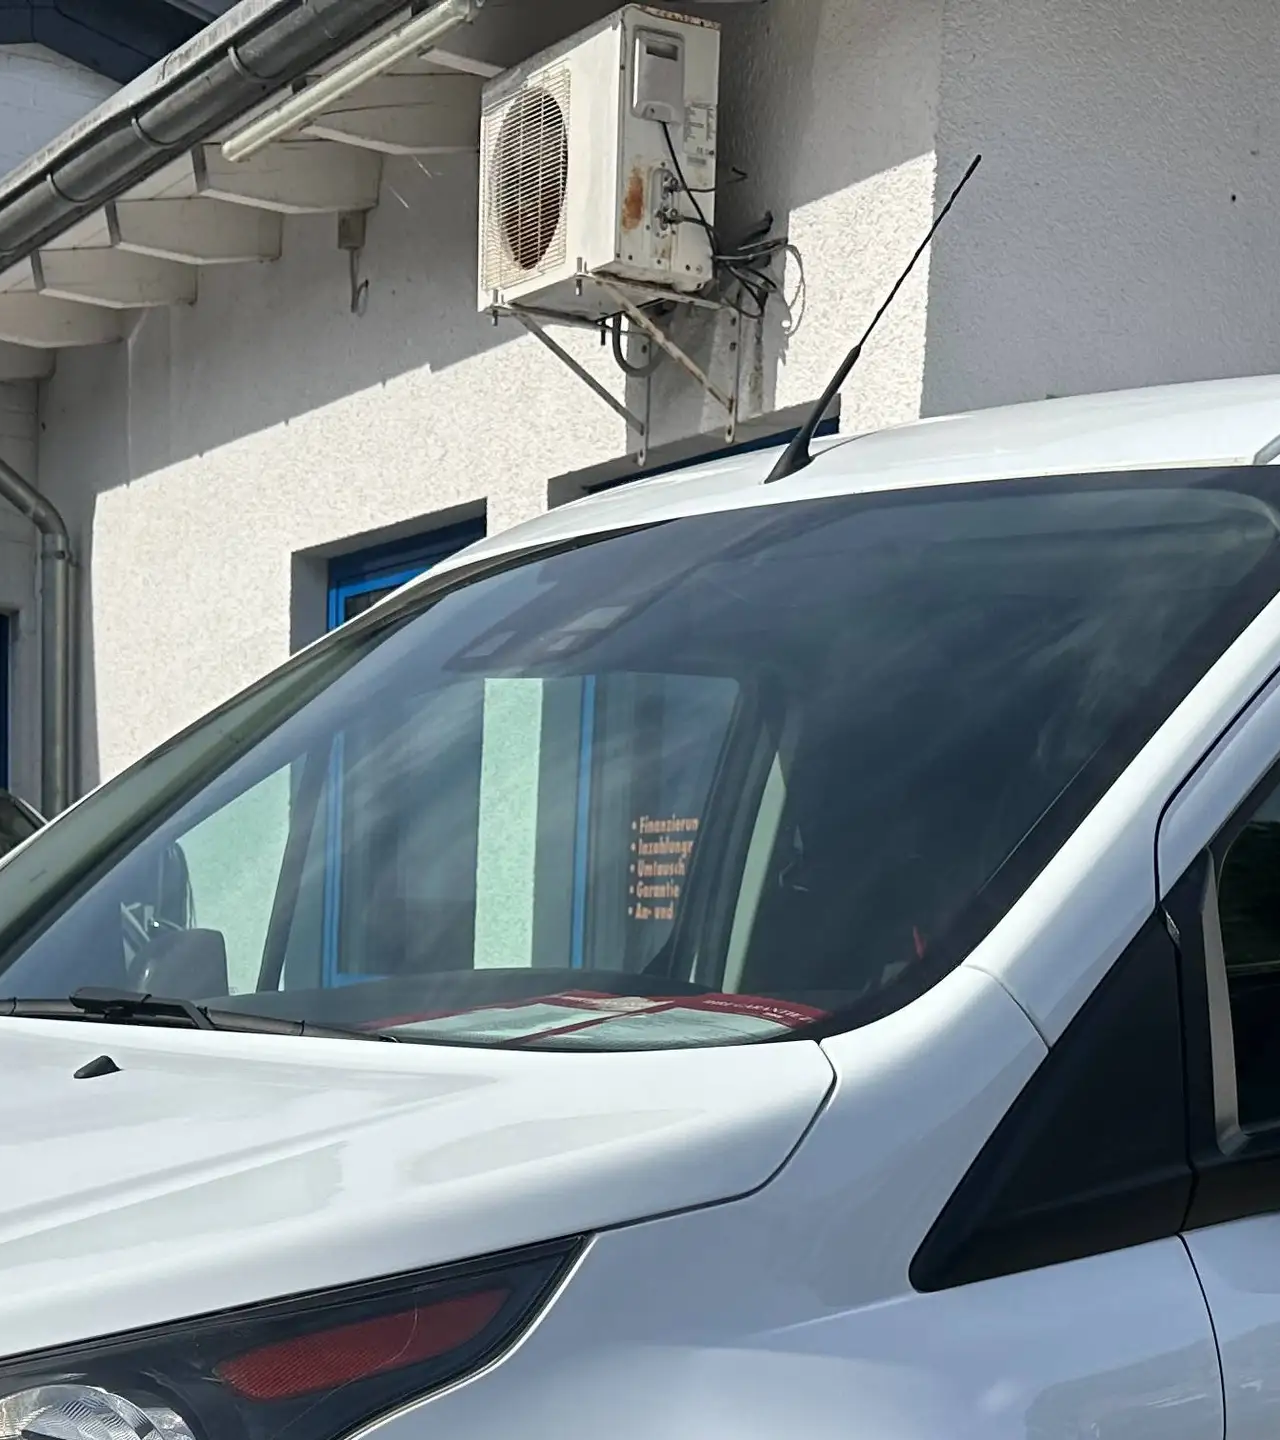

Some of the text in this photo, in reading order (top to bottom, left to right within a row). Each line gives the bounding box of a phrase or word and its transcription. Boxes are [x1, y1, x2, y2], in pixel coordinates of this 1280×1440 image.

[640, 813, 699, 834] Finanzierun
[637, 858, 686, 877] Umtausch
[636, 879, 680, 898] Garantie
[654, 901, 673, 919] und
